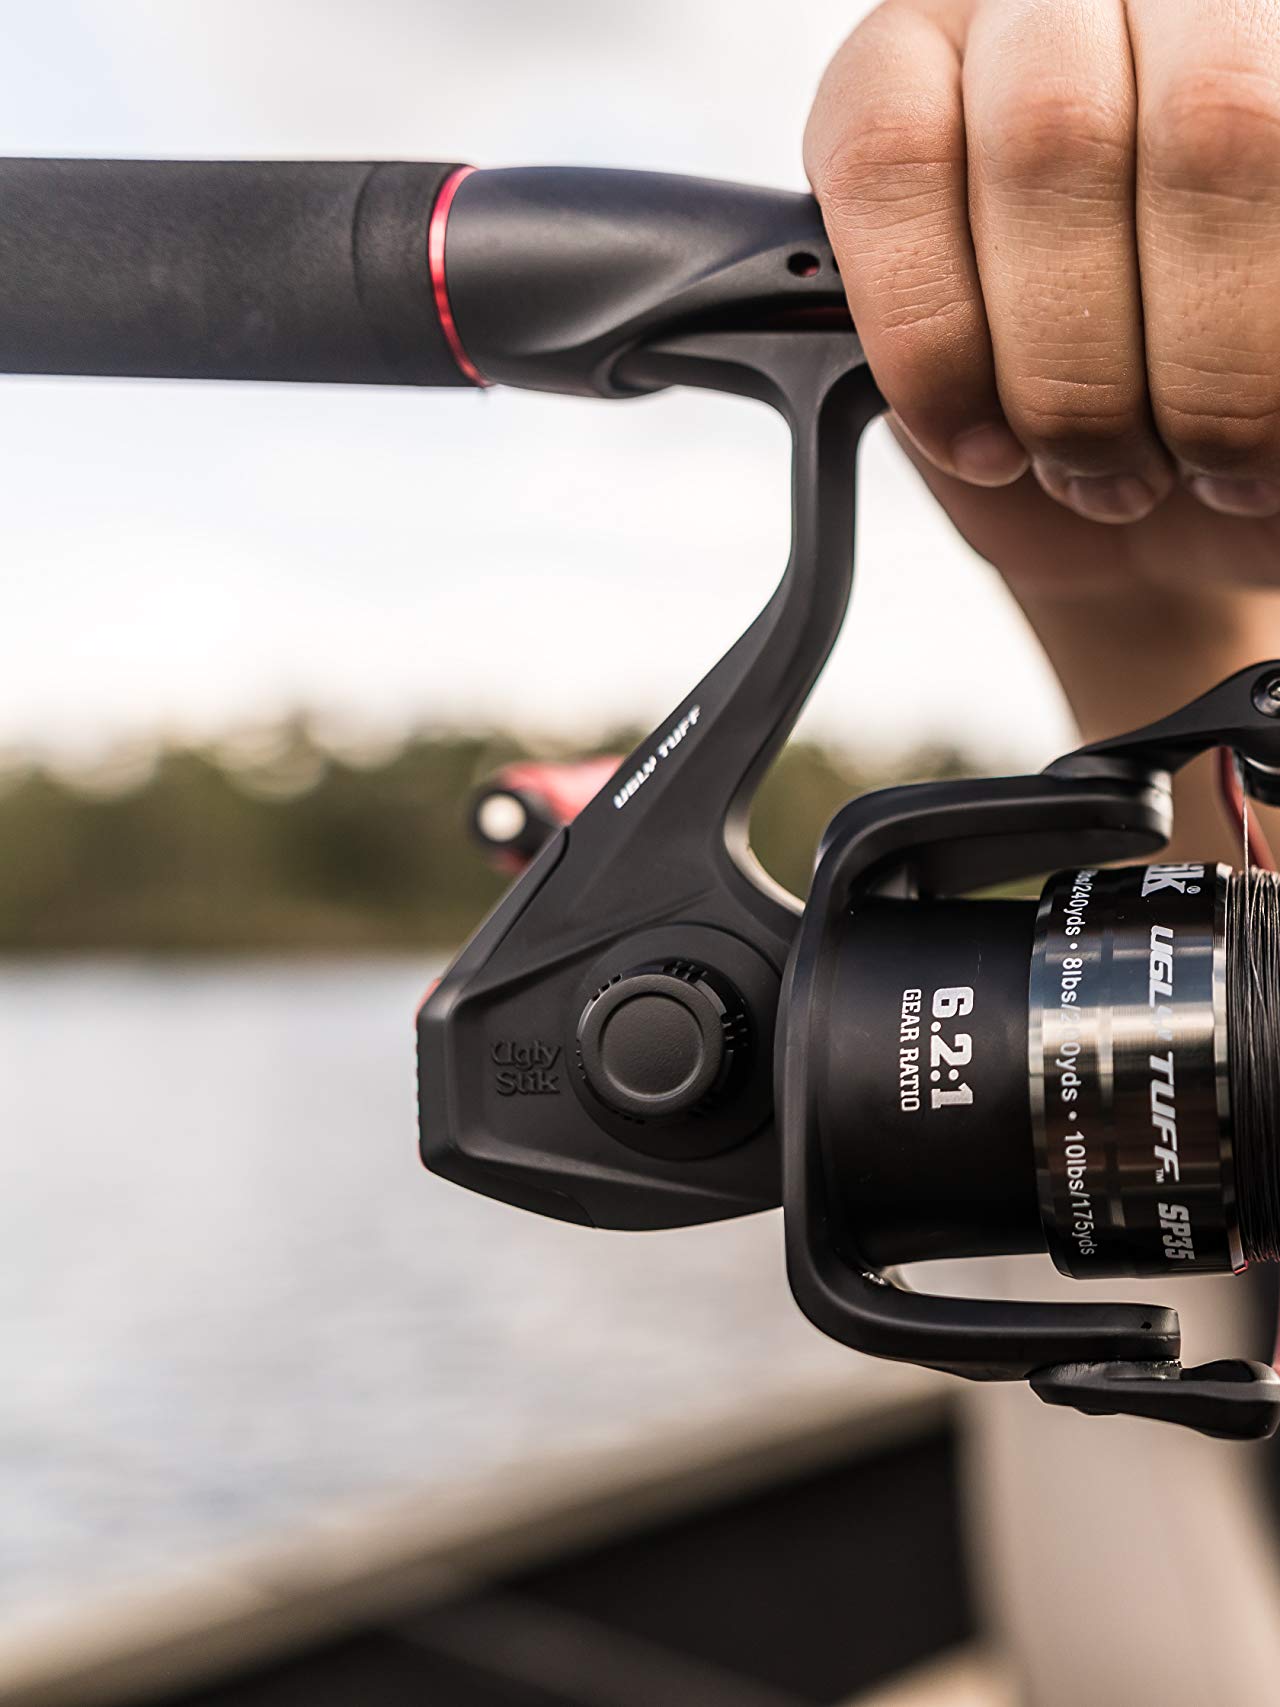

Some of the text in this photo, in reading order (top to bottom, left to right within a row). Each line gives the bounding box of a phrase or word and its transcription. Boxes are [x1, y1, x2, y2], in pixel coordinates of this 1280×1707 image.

[613, 704, 700, 809] UGLY TUFF
[490, 1040, 561, 1071] Ugly
[496, 1071, 561, 1096] Stik
[899, 988, 922, 1112] GEAR RATIO
[930, 986, 974, 1109] 6.2:1
[1063, 1130, 1098, 1256] 10lbs/175yds
[1158, 1202, 1196, 1260] SP35
